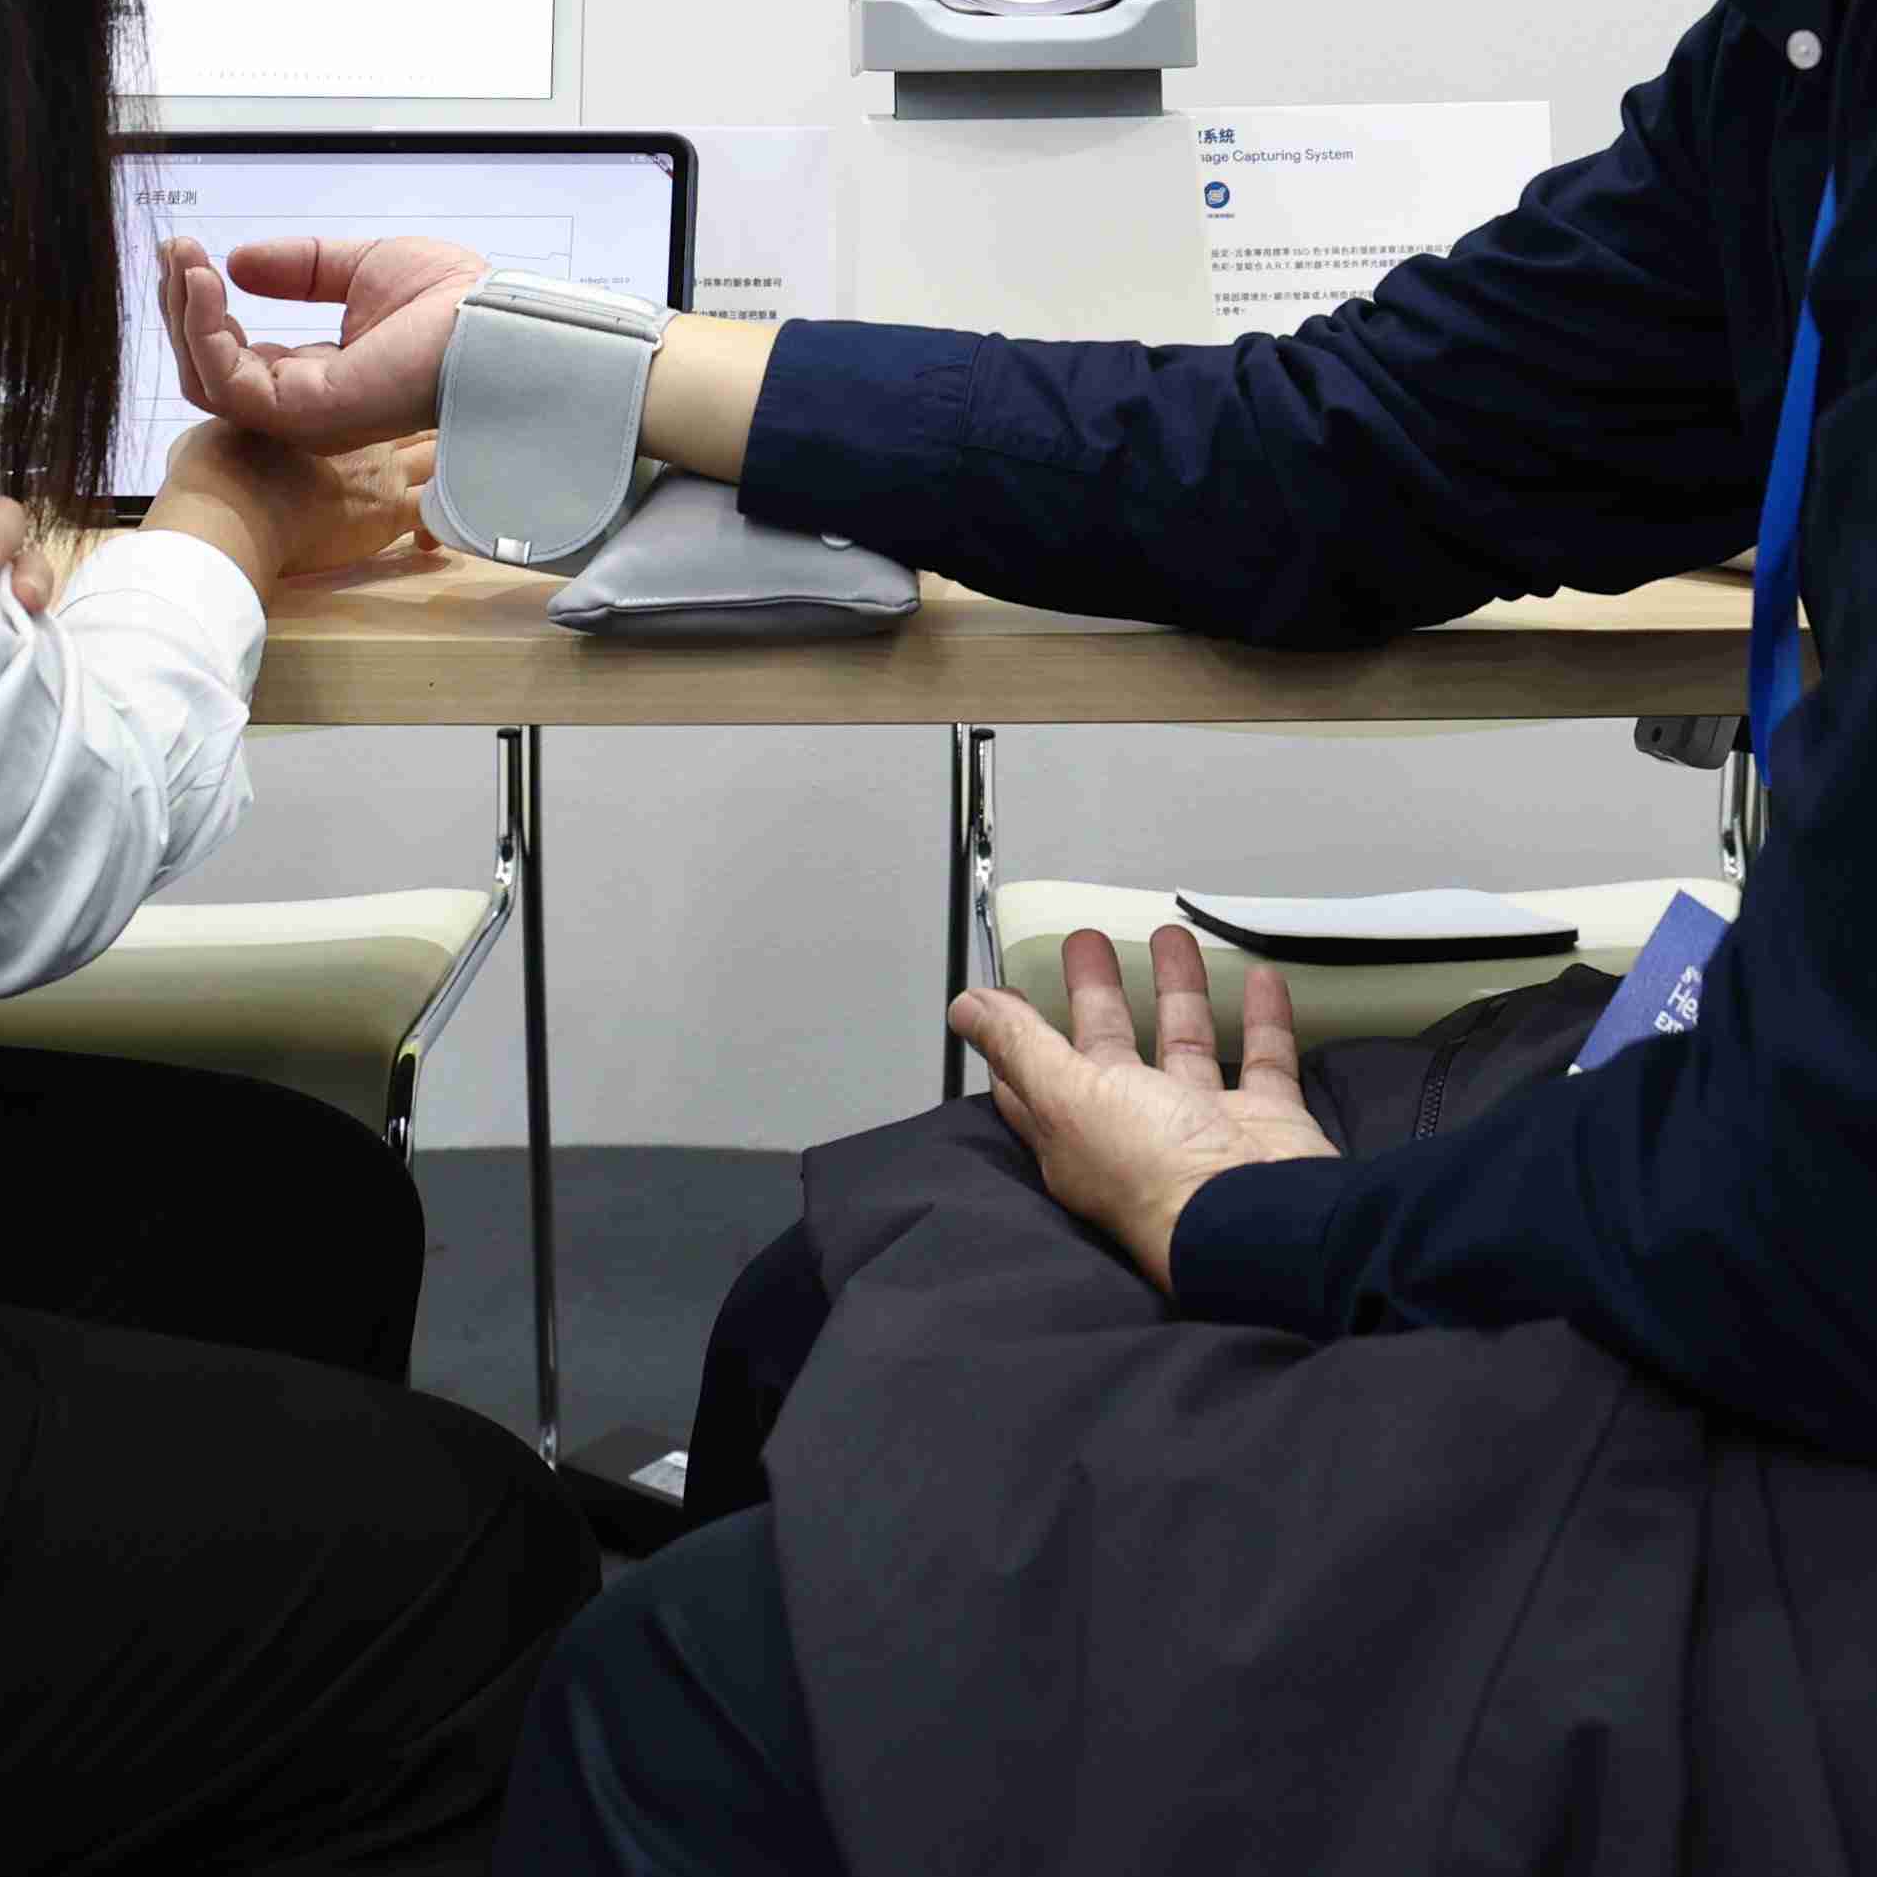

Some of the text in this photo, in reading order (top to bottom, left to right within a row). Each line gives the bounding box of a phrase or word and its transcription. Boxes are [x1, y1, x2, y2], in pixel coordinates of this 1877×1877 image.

[1198, 128, 1236, 144] 系統
[1232, 149, 1301, 164] Capturing
[1305, 148, 1354, 164] System
